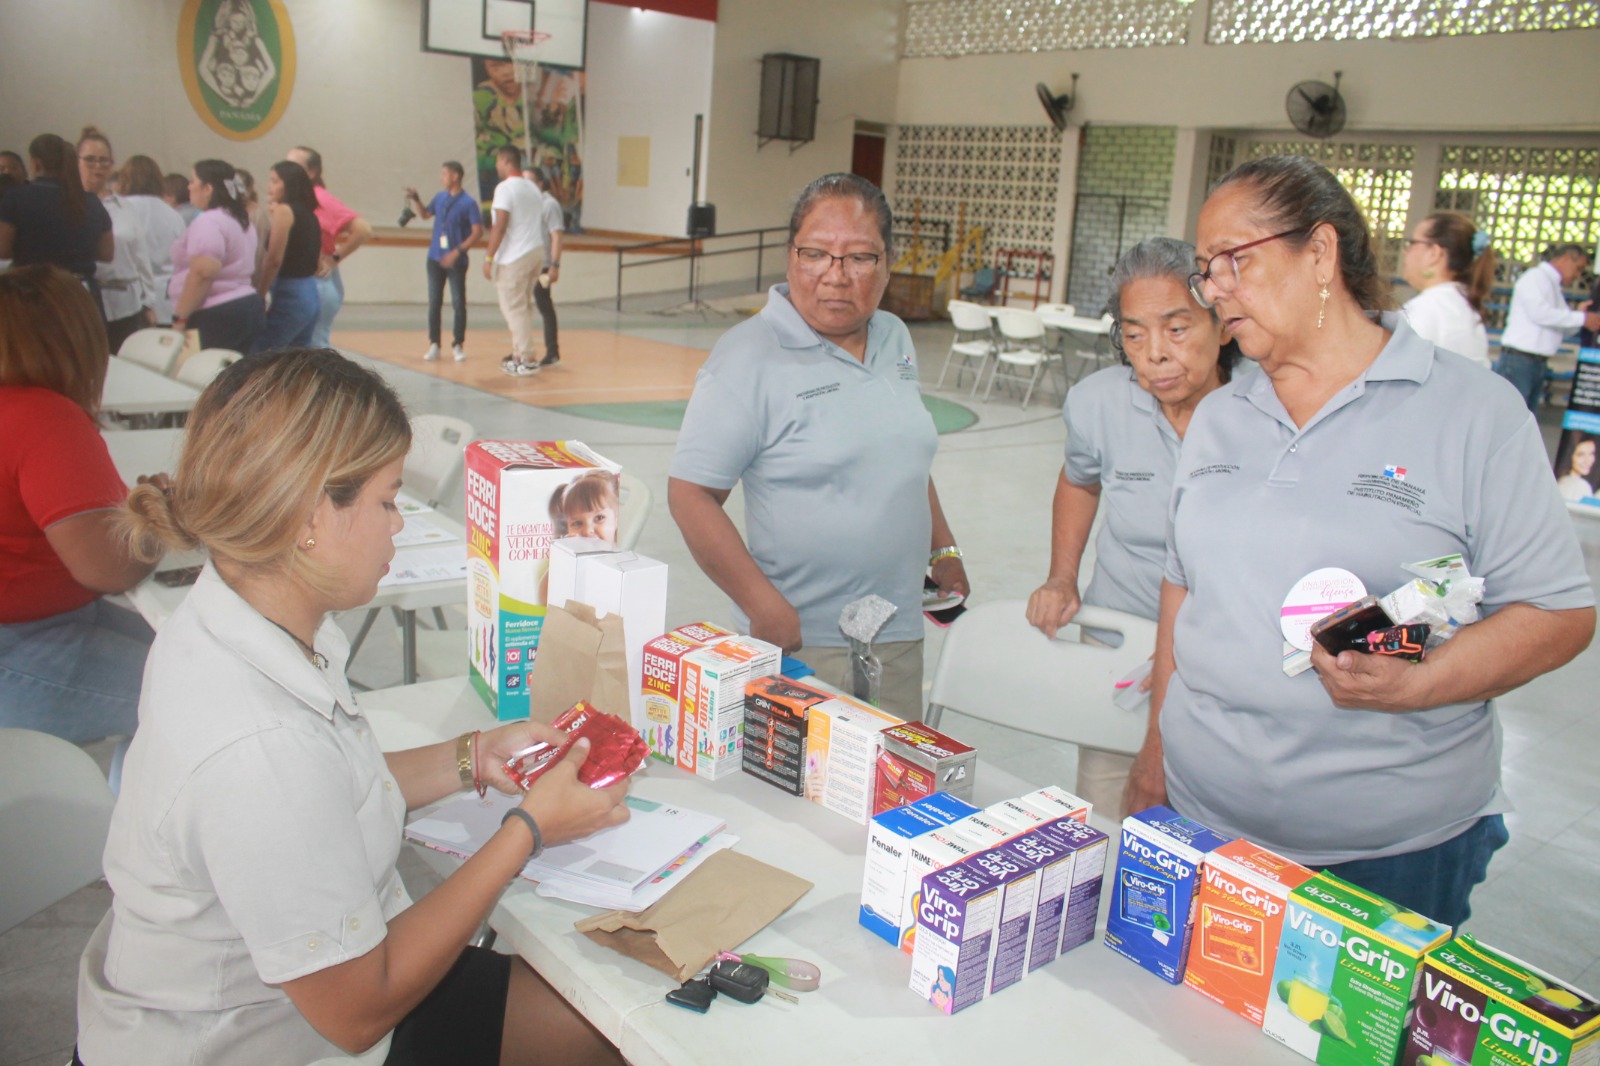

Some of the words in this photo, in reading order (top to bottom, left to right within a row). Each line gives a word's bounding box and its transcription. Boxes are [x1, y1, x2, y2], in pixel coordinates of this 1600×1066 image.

[468, 468, 496, 510] FERRI
[1354, 487, 1385, 496] INSTITUTO
[468, 494, 496, 538] DOCE
[1396, 500, 1422, 516] ESPECIAL
[506, 524, 514, 535] TE
[471, 526, 492, 558] ZINC
[507, 537, 552, 549] VERLOS
[508, 548, 550, 560] COMER
[505, 620, 539, 628] Ferridoce
[644, 653, 676, 672] FERRI
[644, 664, 677, 684] DOCE
[648, 678, 671, 692] ZINC
[700, 685, 709, 730] FORTE
[1038, 790, 1076, 811] TRIMETOSE
[901, 807, 936, 826] Fenaler
[921, 802, 958, 822] Fenaler
[1003, 802, 1044, 821] TRIMETOSE
[968, 816, 1008, 836] TRIMETOSE
[1056, 822, 1088, 839] Grip
[1067, 818, 1097, 836] Viro-
[1149, 820, 1192, 845] Viro-Grip
[872, 834, 902, 858] Fenaler
[929, 832, 970, 854] TRIMETOSE
[1013, 842, 1044, 862] Viro-
[1022, 838, 1055, 856] Grip
[911, 848, 946, 870] TRIMETOS
[985, 853, 1019, 873] Grip
[1122, 830, 1190, 880] Viro-Grip
[976, 858, 1005, 880] Viro-
[1232, 856, 1280, 881] Viro-Grip
[936, 875, 968, 897] Viro-
[946, 870, 980, 891] Grip
[1130, 875, 1165, 896] Viro-Grip
[923, 882, 961, 917] Viro-
[1205, 866, 1280, 917] Viro-Grip
[1304, 885, 1370, 920] Viro-Grip
[920, 902, 959, 940] Grip
[1212, 913, 1252, 933] Viro-Grip
[1341, 918, 1354, 927] WITH
[1288, 904, 1406, 982] Viro-Grip
[1340, 958, 1382, 982] Limón
[1440, 951, 1514, 994] Viro-Grip
[1350, 977, 1362, 987] Extra
[1362, 983, 1382, 996] Strength
[1445, 968, 1458, 976] NEW
[1458, 974, 1484, 990] FORMULA
[1485, 987, 1500, 998] WITH
[1500, 996, 1548, 1024] PHENYLEPHRINE
[1379, 1010, 1389, 1018] Cold
[1425, 971, 1558, 1066] Viro-Grip
